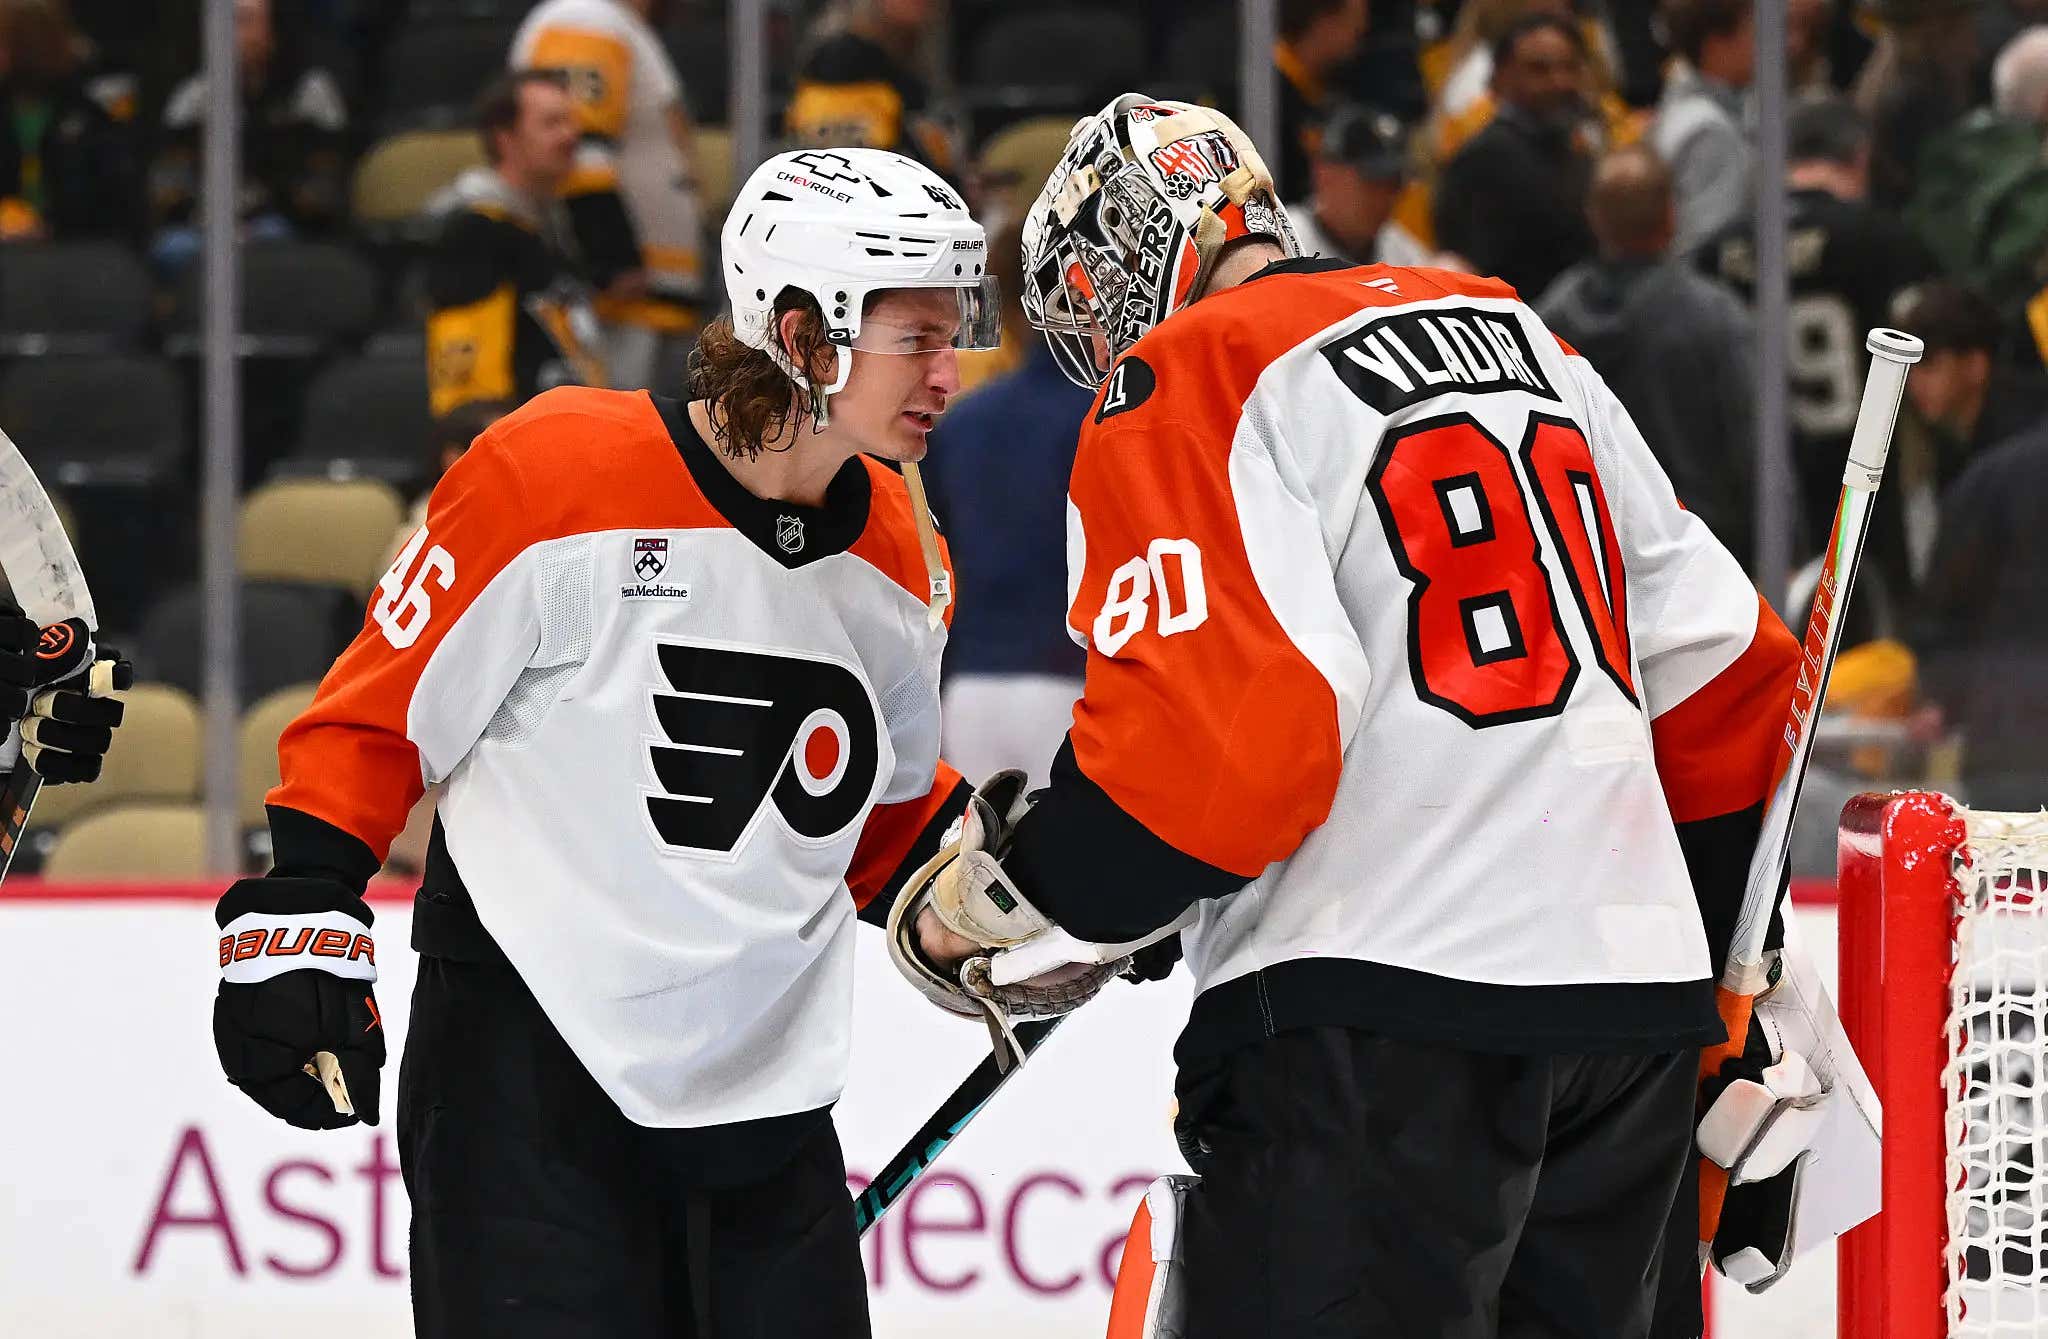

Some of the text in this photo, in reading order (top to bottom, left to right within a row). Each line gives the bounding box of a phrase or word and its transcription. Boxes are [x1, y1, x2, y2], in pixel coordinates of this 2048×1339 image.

[777, 171, 854, 203] CHEVROLET
[1343, 315, 1546, 393] VLADAR
[782, 526, 798, 544] NHL
[1366, 411, 1641, 730] 80
[372, 524, 457, 650] 46
[635, 585, 688, 598] Medicine
[1093, 537, 1209, 658] 80
[1784, 567, 1838, 757] FLYLITE
